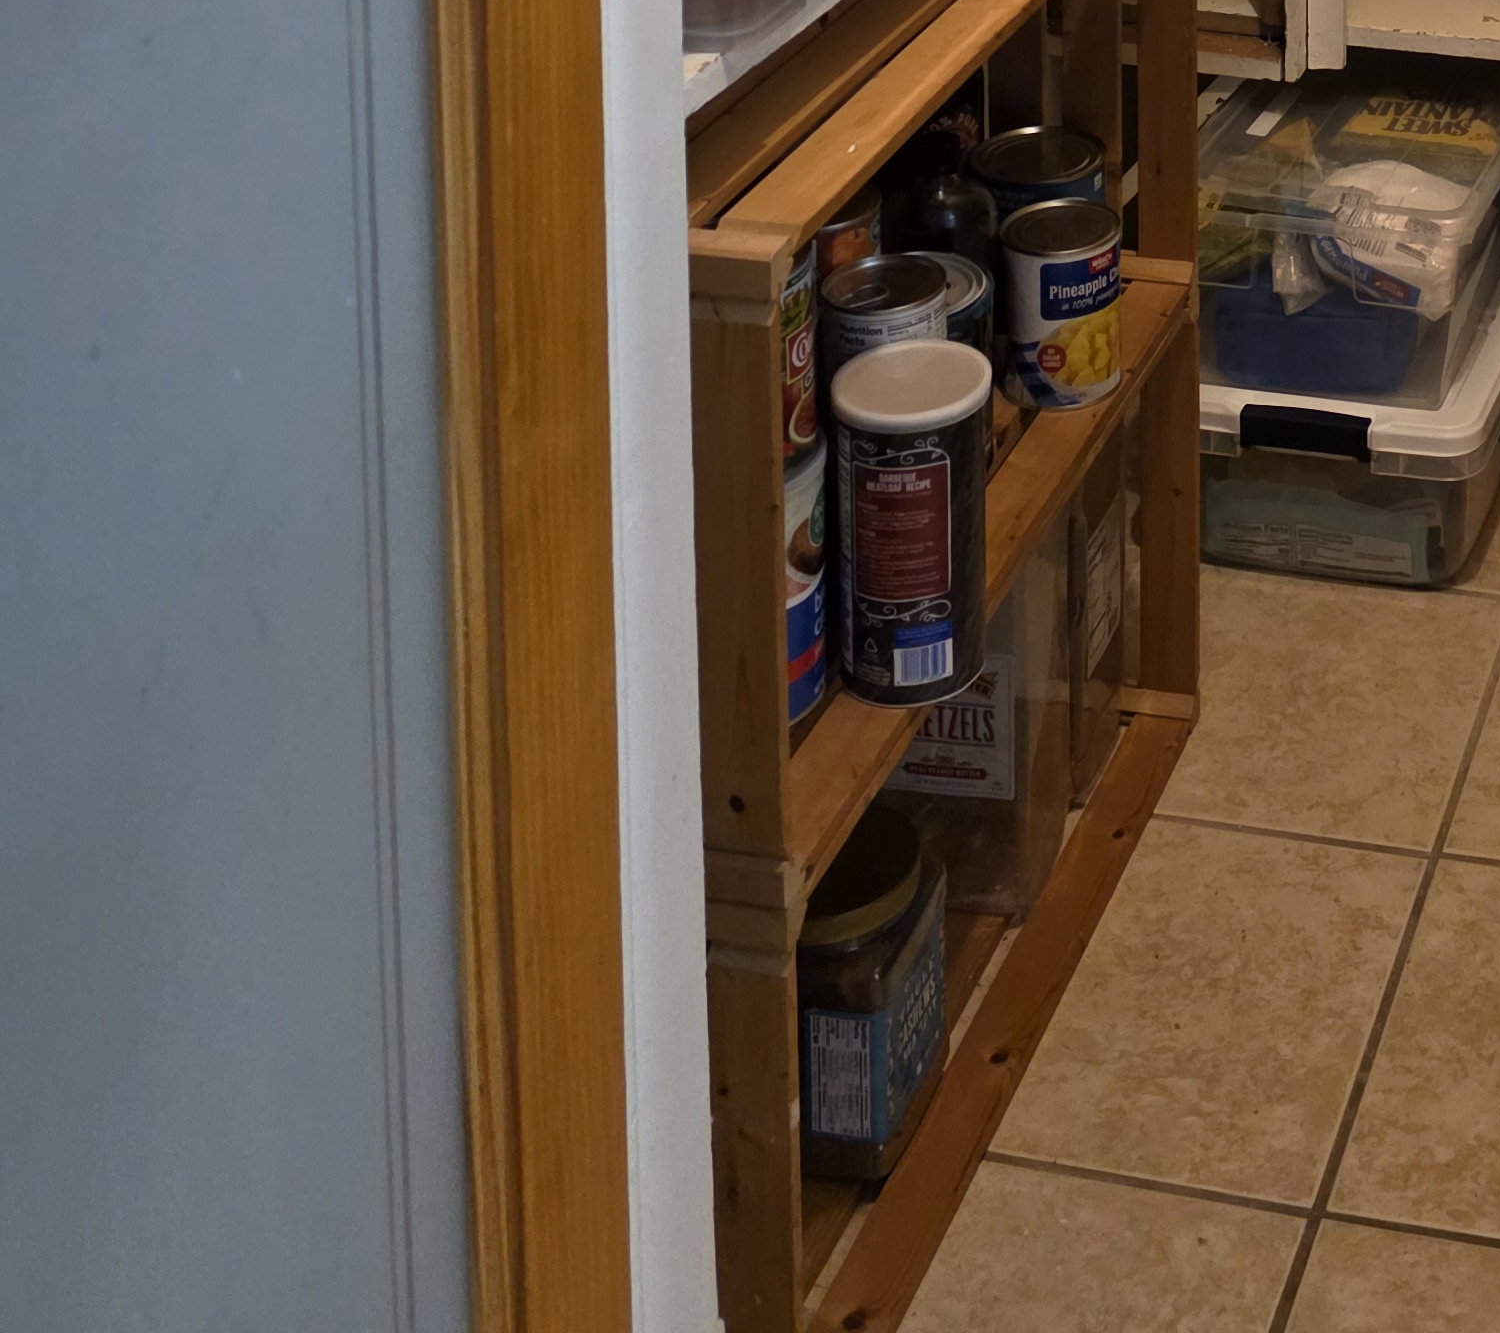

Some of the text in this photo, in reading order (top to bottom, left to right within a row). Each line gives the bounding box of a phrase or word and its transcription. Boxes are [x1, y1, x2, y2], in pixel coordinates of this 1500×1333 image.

[1382, 117, 1472, 136] SWEET
[1049, 275, 1107, 300] Pineapple
[1072, 298, 1094, 311] 100%
[840, 322, 883, 346] Nutrition Facts
[906, 479, 931, 491] RECIPE
